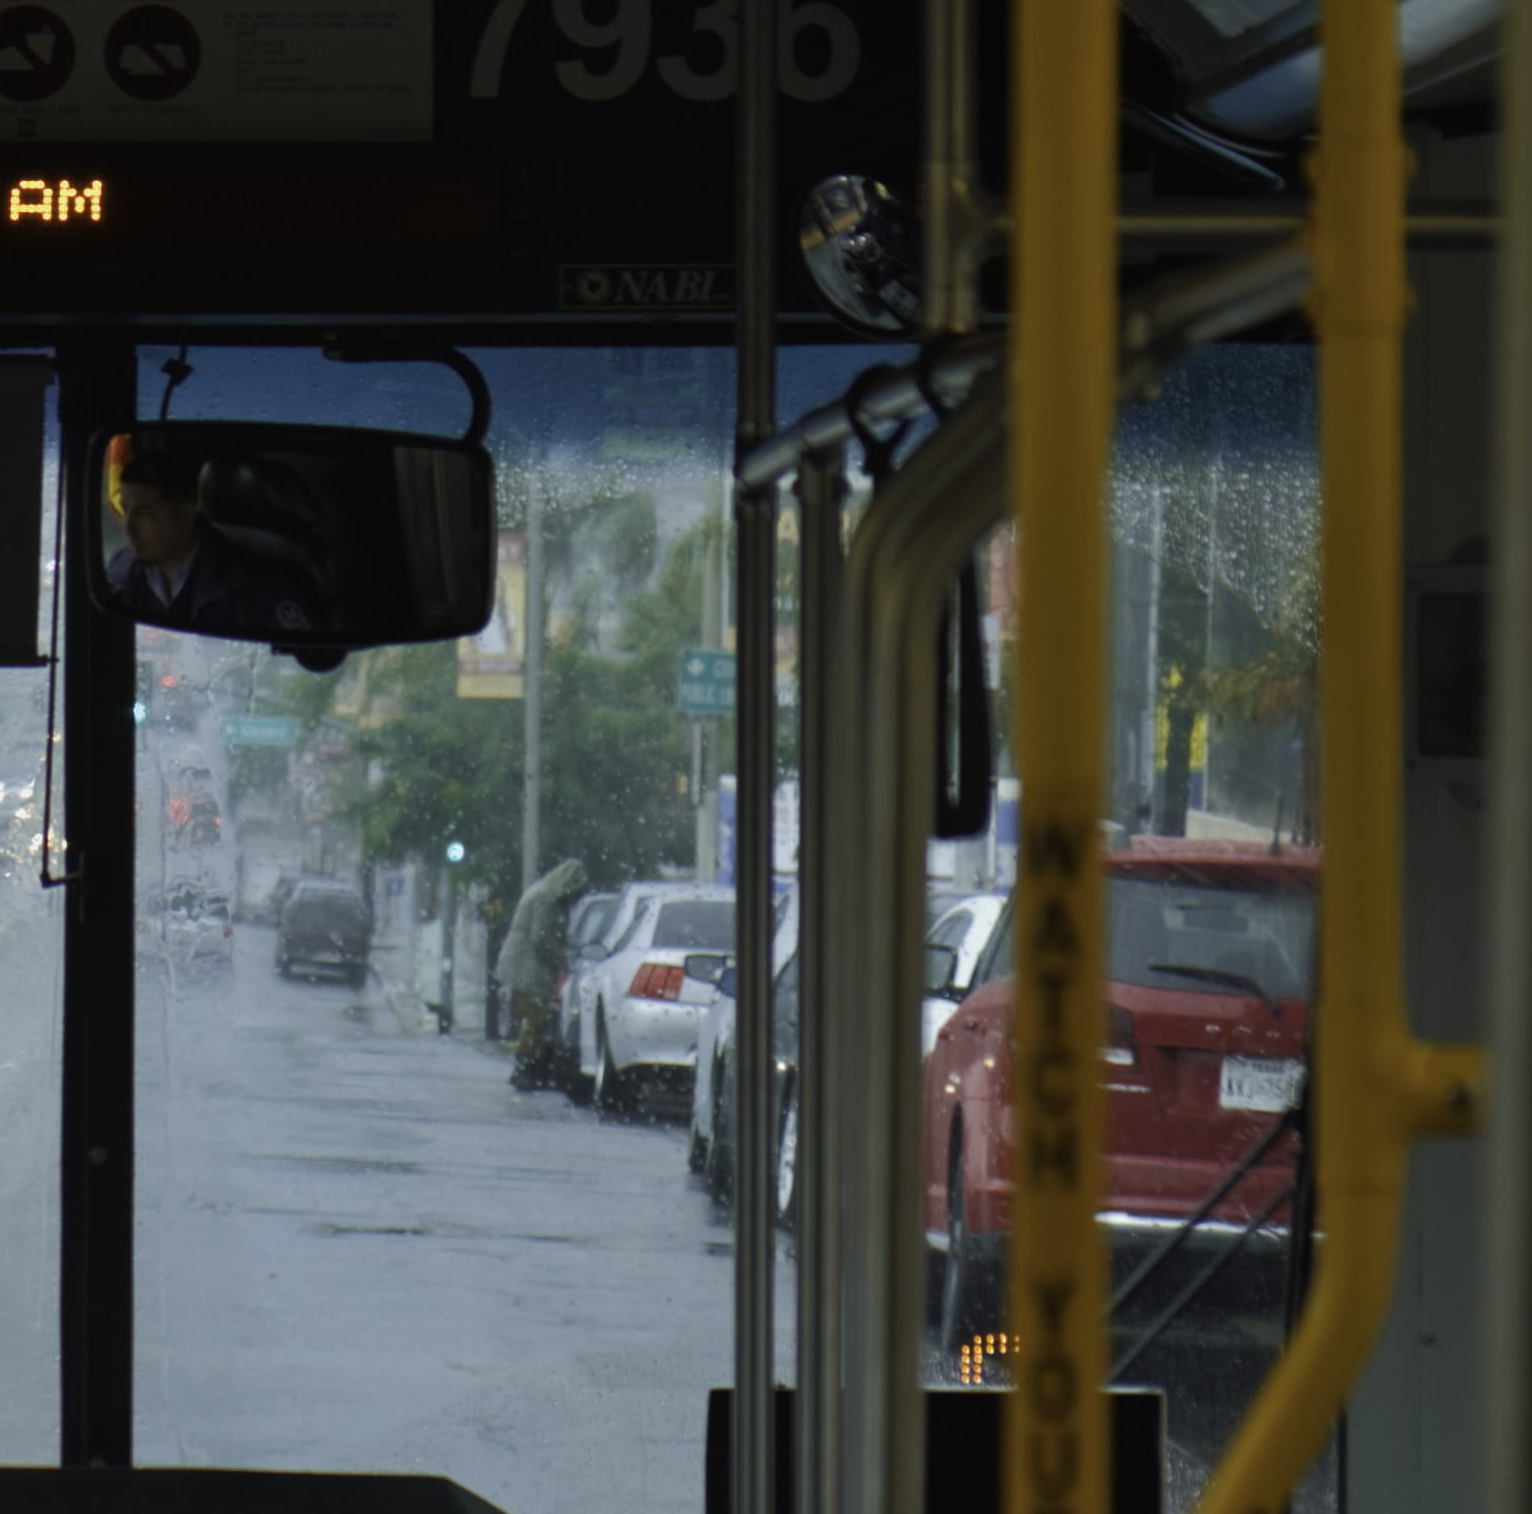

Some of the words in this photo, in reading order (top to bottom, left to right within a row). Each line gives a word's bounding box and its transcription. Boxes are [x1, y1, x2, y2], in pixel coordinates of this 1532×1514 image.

[10, 179, 103, 222] AM
[612, 270, 717, 304] NABI
[1030, 814, 1085, 1194] WATCH
